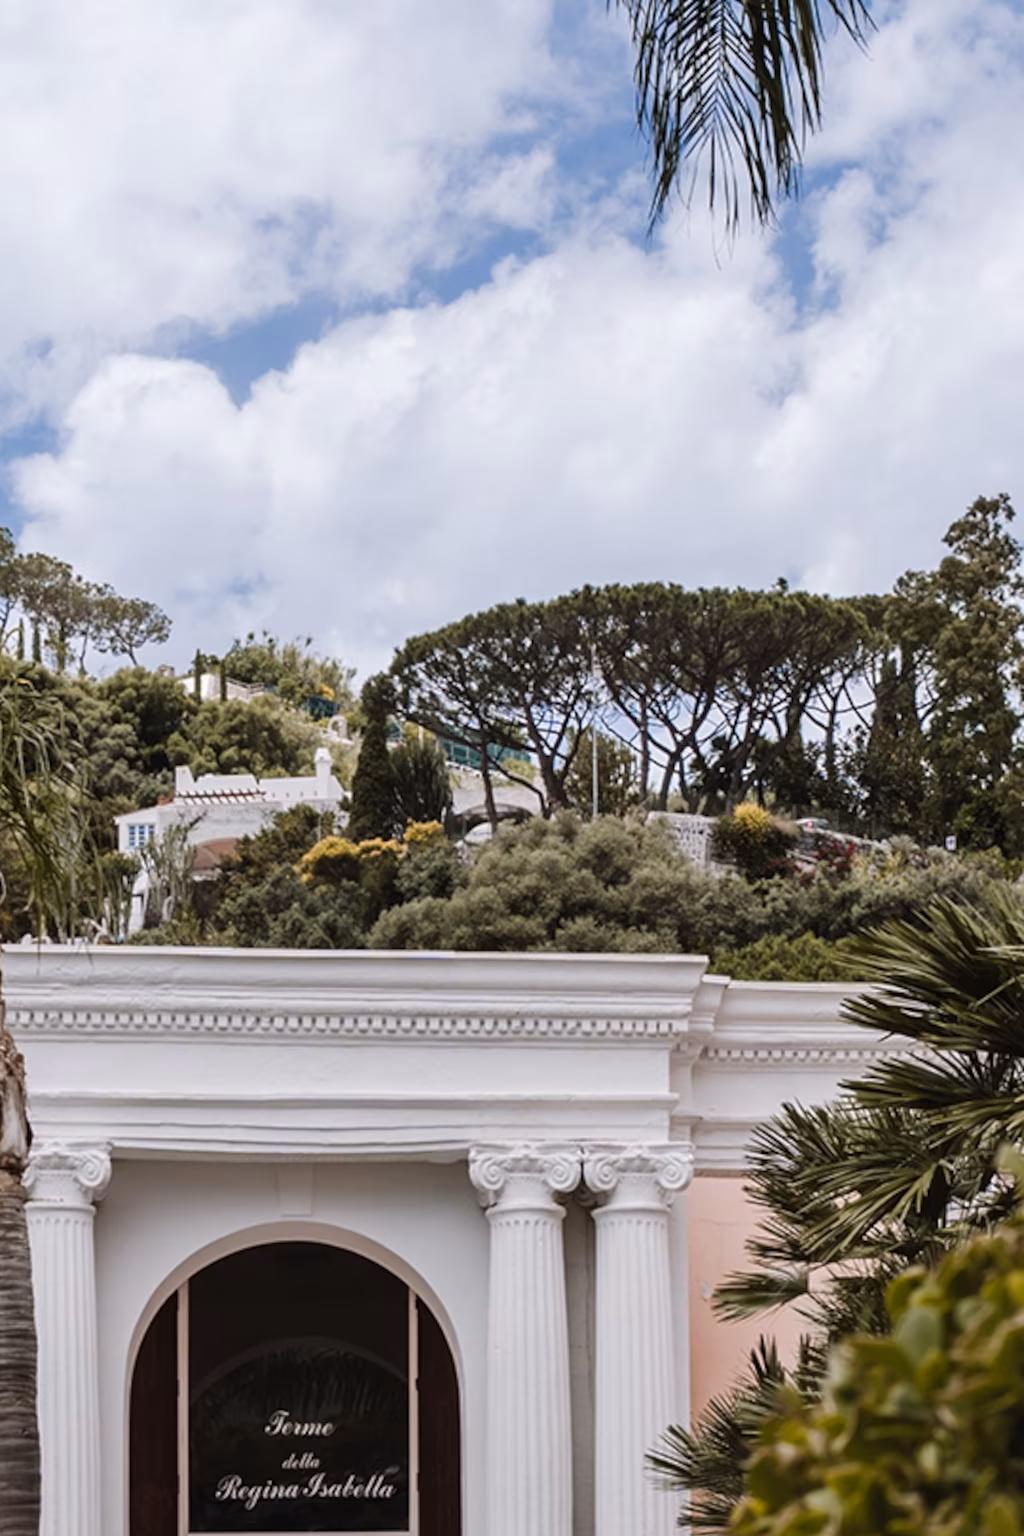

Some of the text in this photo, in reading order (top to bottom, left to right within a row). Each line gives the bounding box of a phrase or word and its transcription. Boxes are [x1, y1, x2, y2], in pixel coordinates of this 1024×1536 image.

[264, 1409, 336, 1436] Terme
[281, 1451, 320, 1470] della
[215, 1472, 396, 1510] Regina Isabella
